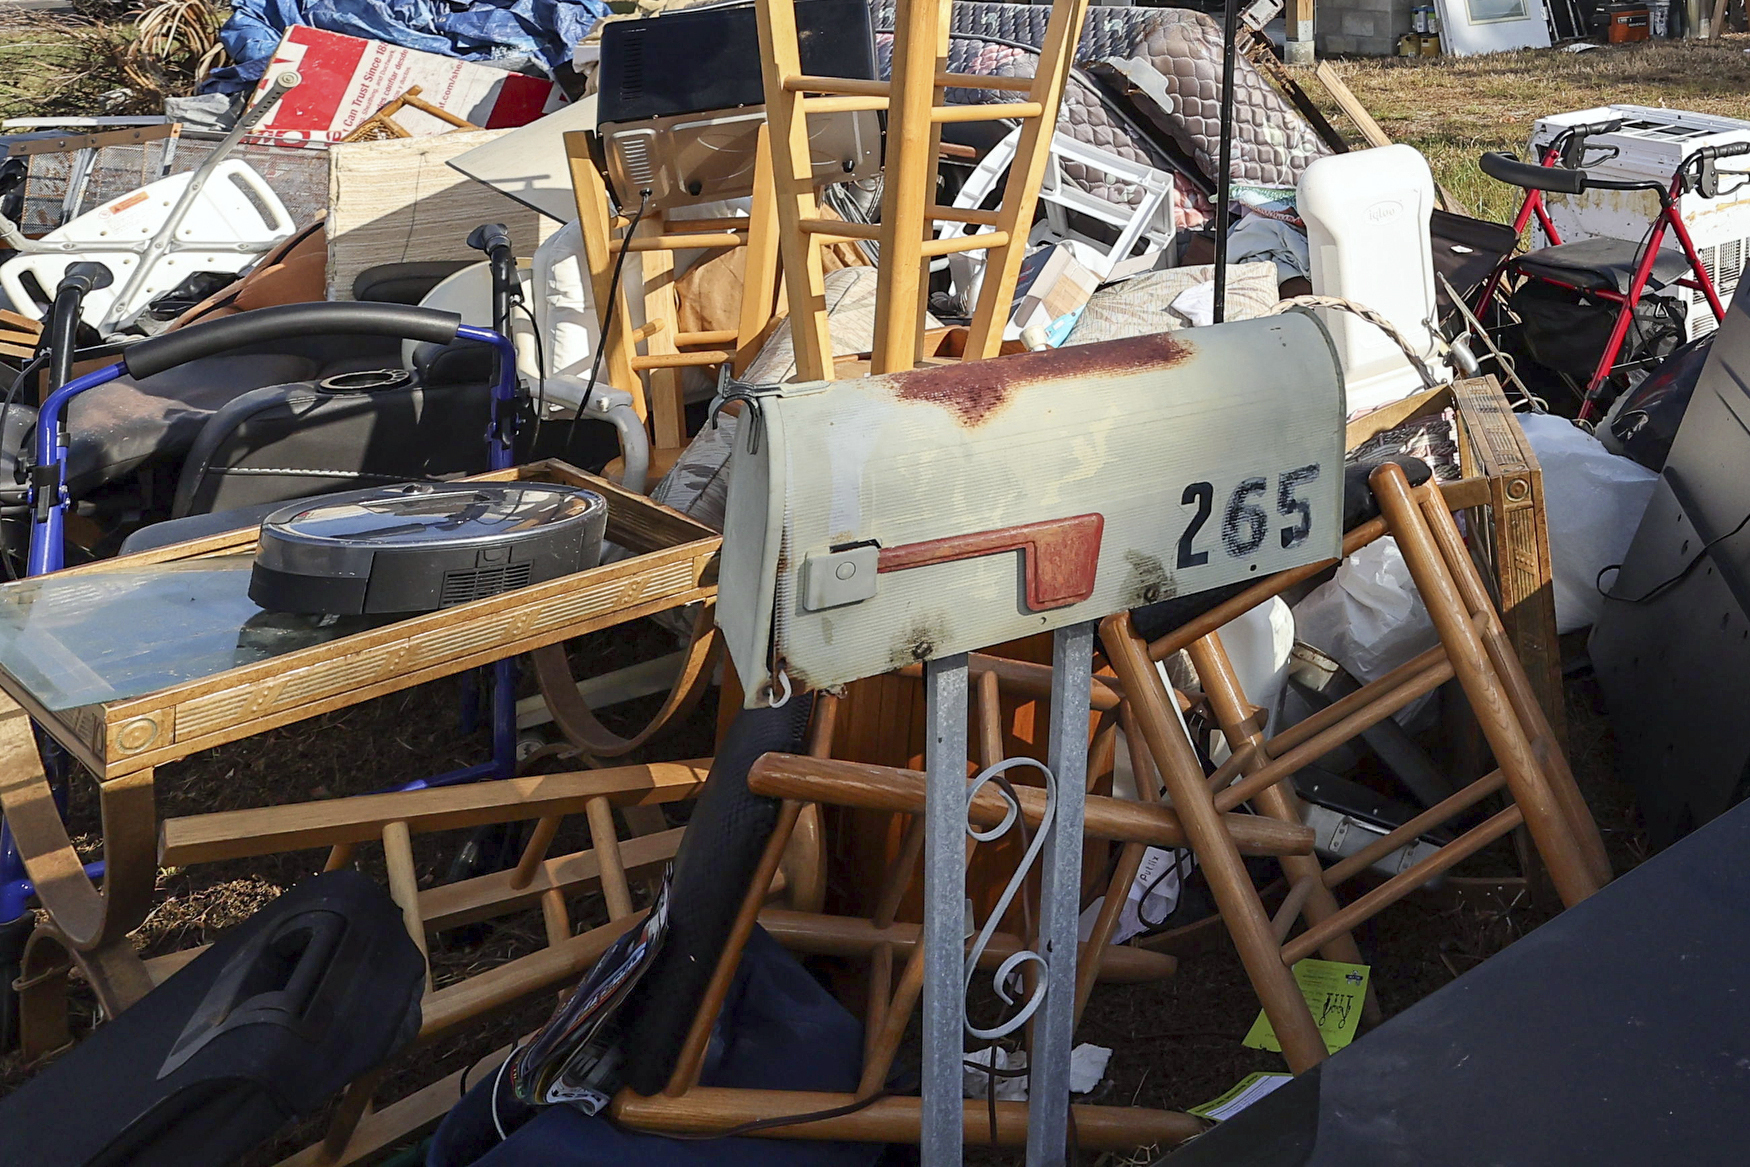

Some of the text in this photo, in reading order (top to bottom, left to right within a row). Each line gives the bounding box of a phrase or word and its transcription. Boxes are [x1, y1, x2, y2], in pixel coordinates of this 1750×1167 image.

[344, 108, 358, 127] Can
[351, 83, 370, 108] Trust
[364, 56, 382, 82] Since
[383, 71, 398, 96] confiar
[395, 48, 409, 70] desde
[1369, 207, 1395, 222] igloo
[1177, 462, 1320, 569] 265
